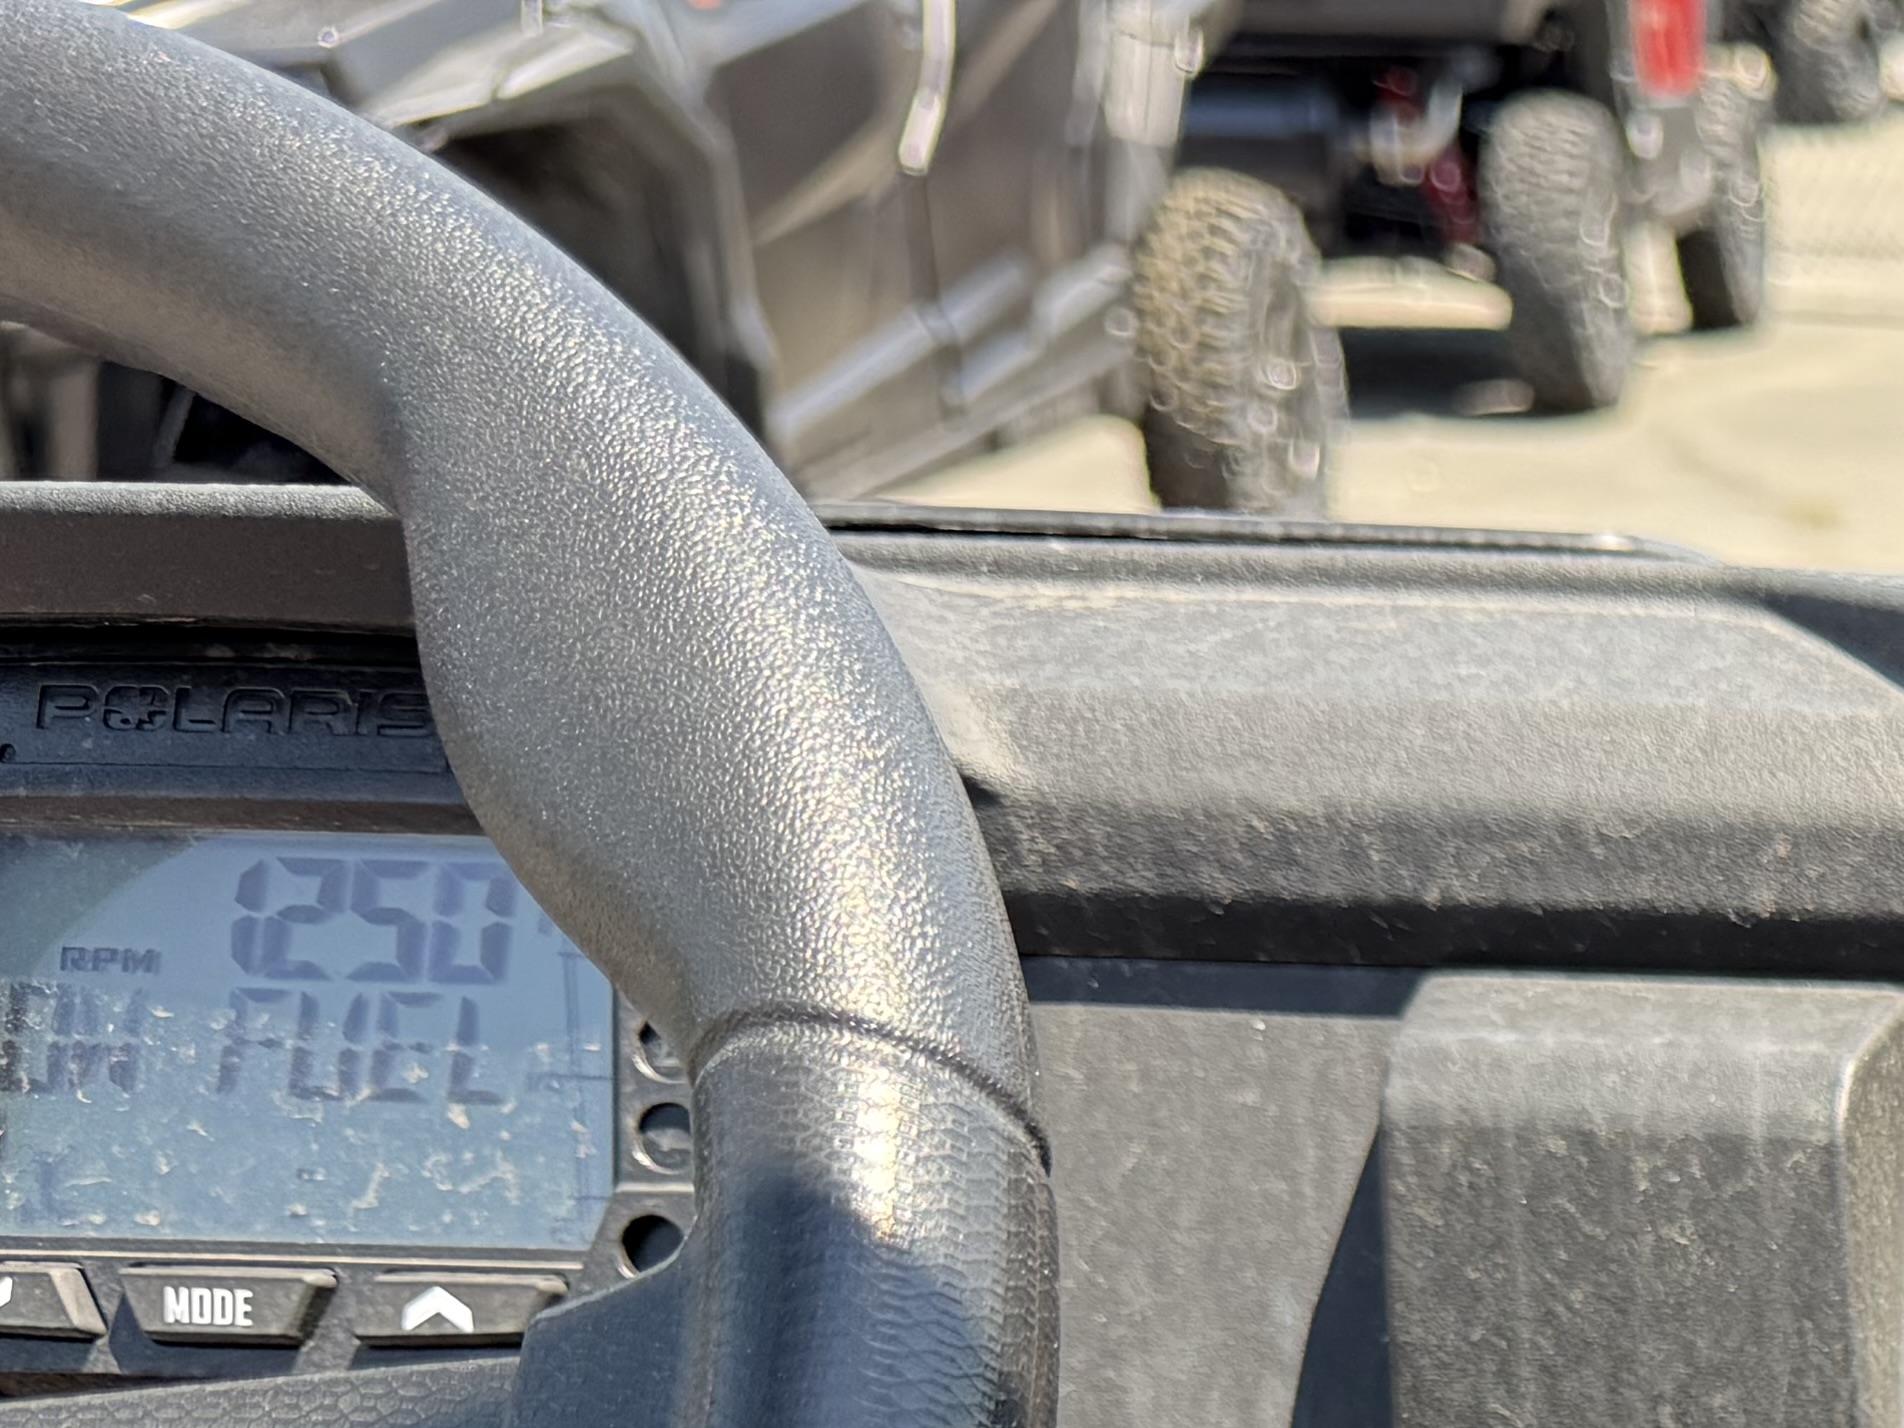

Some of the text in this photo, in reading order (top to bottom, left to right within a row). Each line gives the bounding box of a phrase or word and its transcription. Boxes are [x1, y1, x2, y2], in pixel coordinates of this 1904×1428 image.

[60, 946, 161, 974] RPM
[231, 857, 518, 985] 1250
[217, 986, 505, 1104] FUEL
[162, 1286, 254, 1327] MODE
